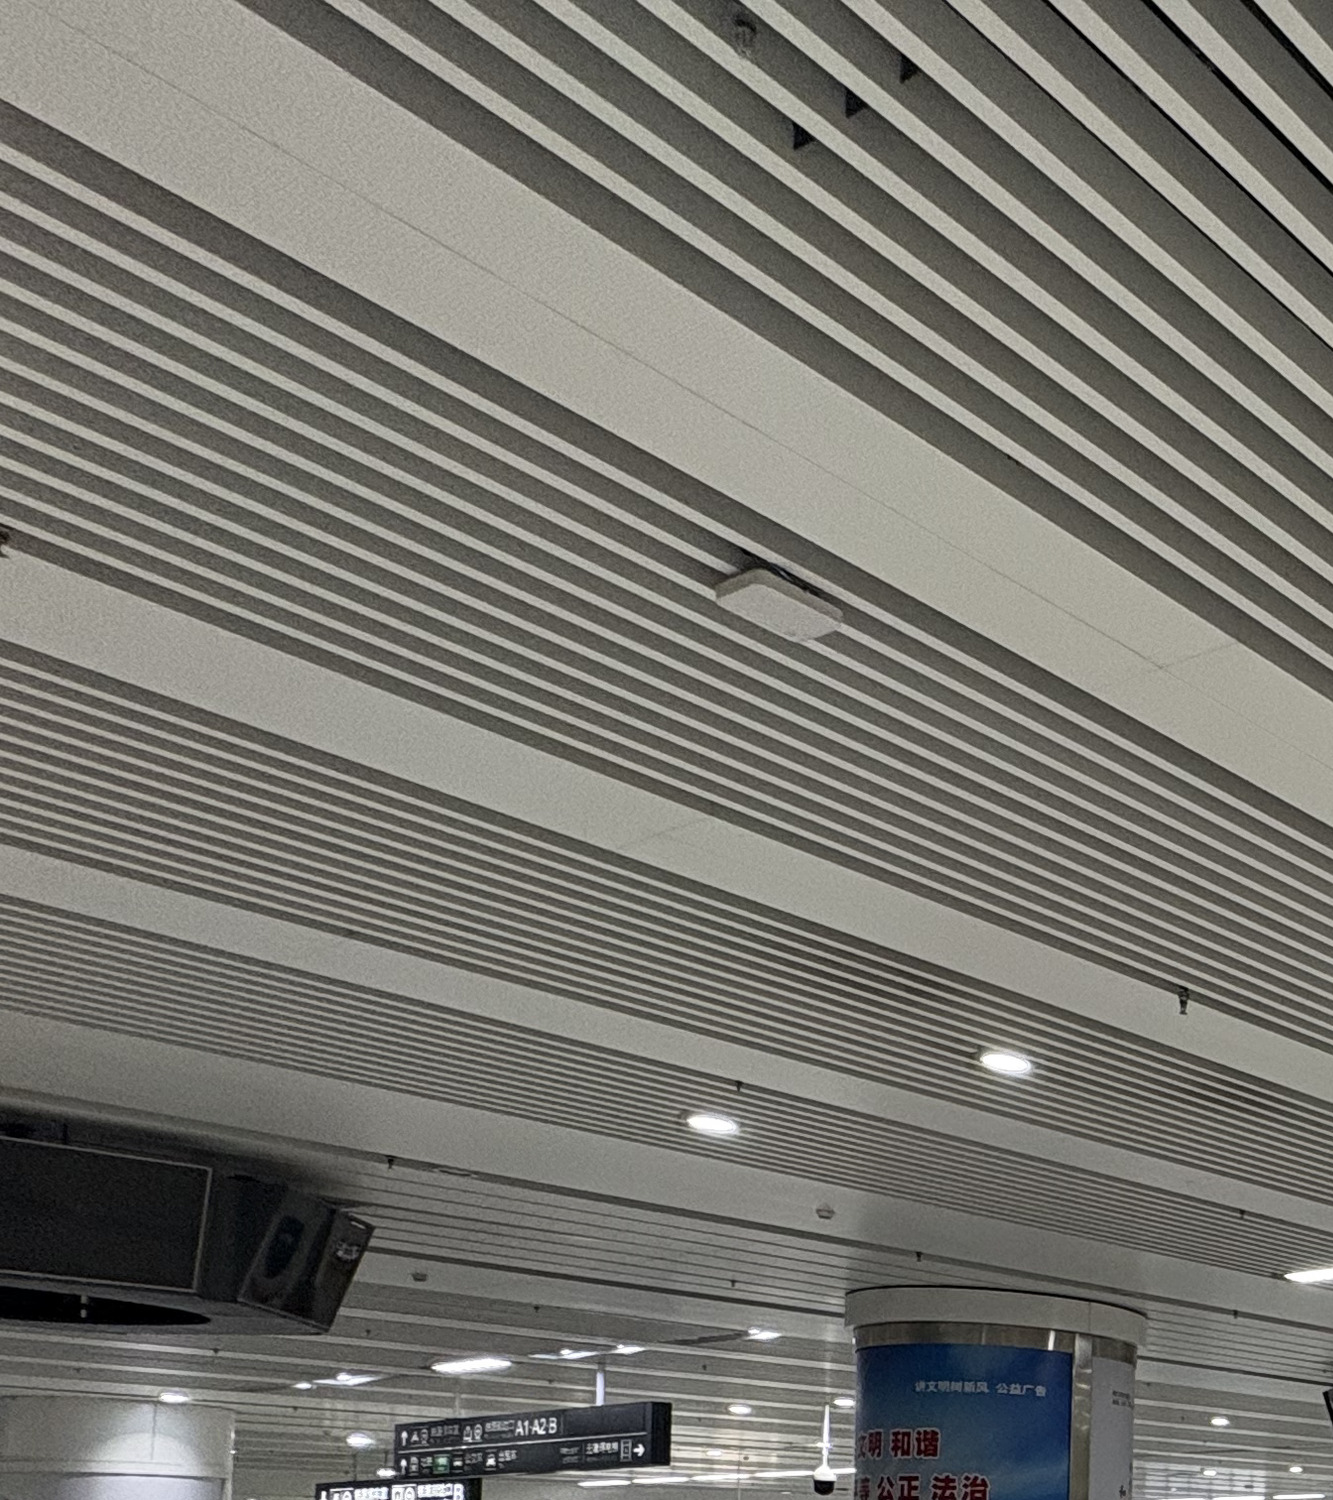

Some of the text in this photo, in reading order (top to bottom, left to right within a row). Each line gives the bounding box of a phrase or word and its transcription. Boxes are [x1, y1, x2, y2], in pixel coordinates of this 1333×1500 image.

[995, 1382, 1047, 1397] 公益广告
[891, 1427, 941, 1459] 和谐
